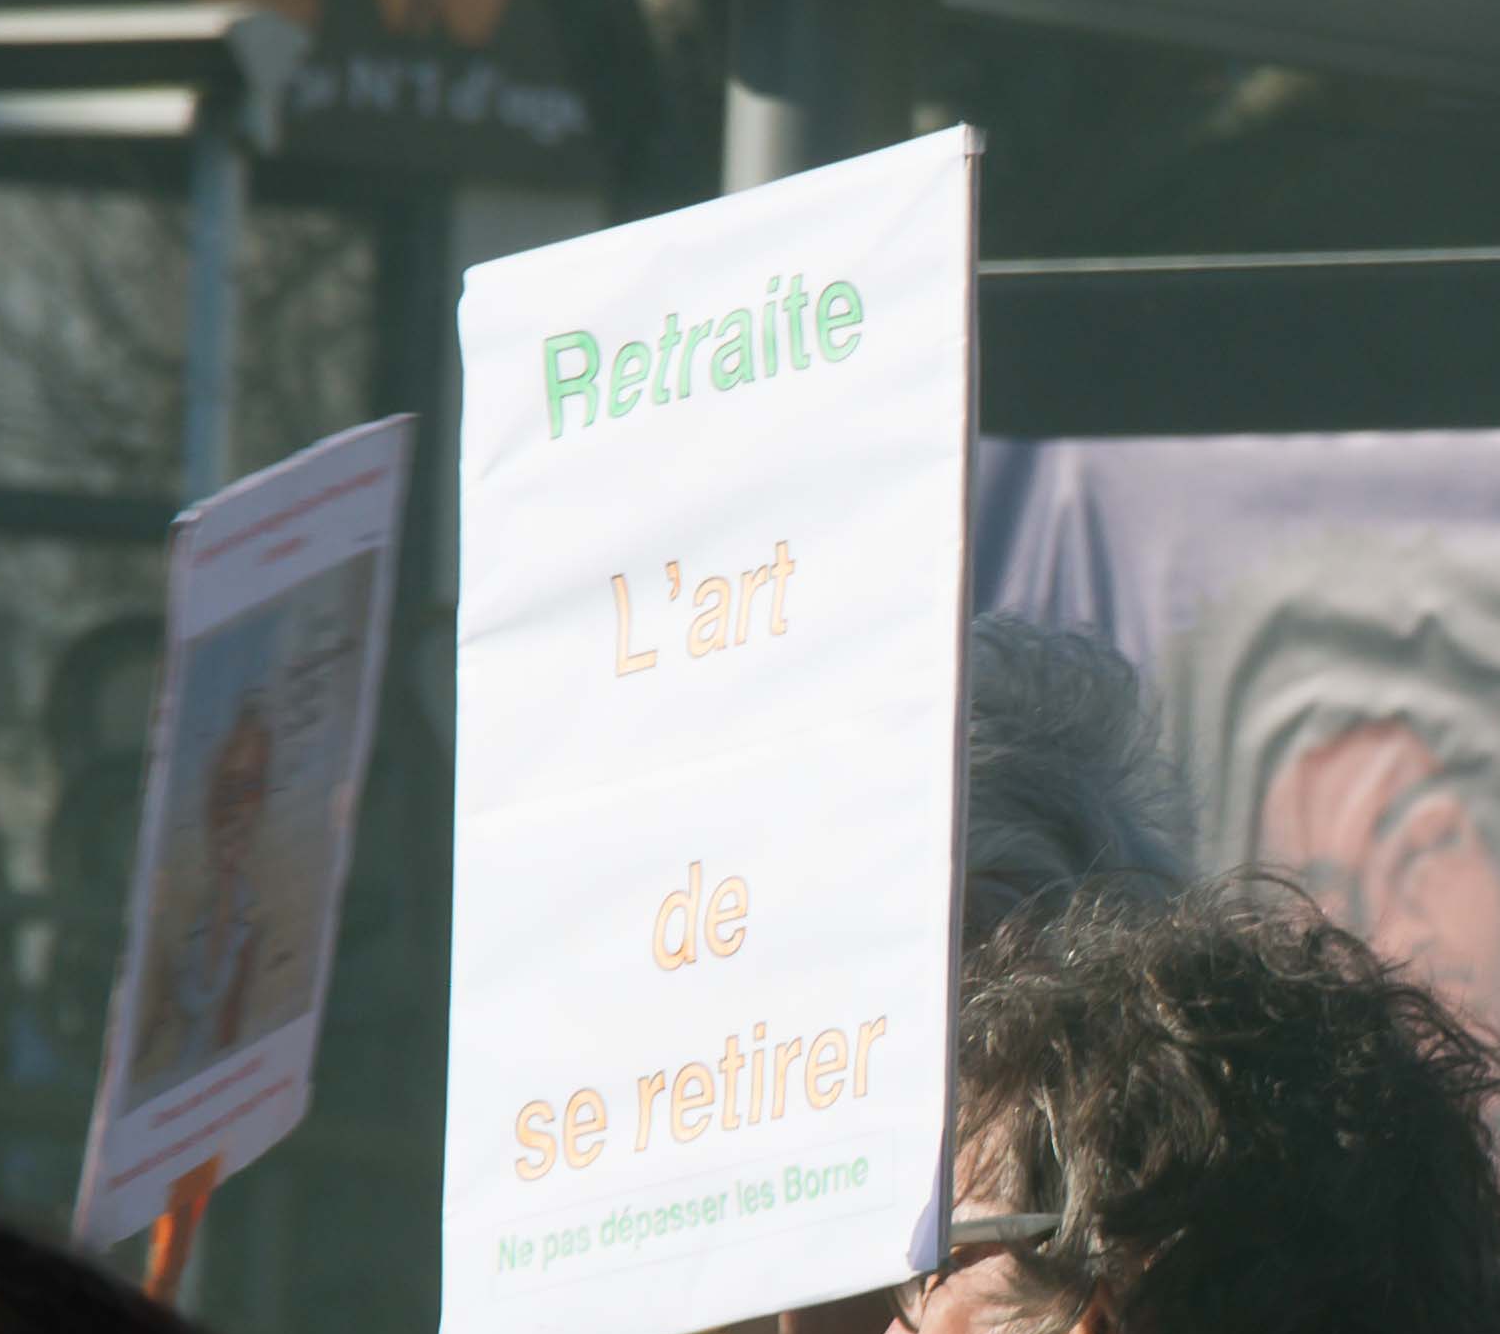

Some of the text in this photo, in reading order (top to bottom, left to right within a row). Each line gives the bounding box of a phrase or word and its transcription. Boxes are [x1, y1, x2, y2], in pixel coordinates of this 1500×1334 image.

[544, 274, 864, 440] Retraite
[611, 540, 795, 677] L’art
[652, 861, 749, 971] de
[513, 1015, 887, 1181] se retirer
[498, 1155, 870, 1273] Ne pas dépasser les Borne
